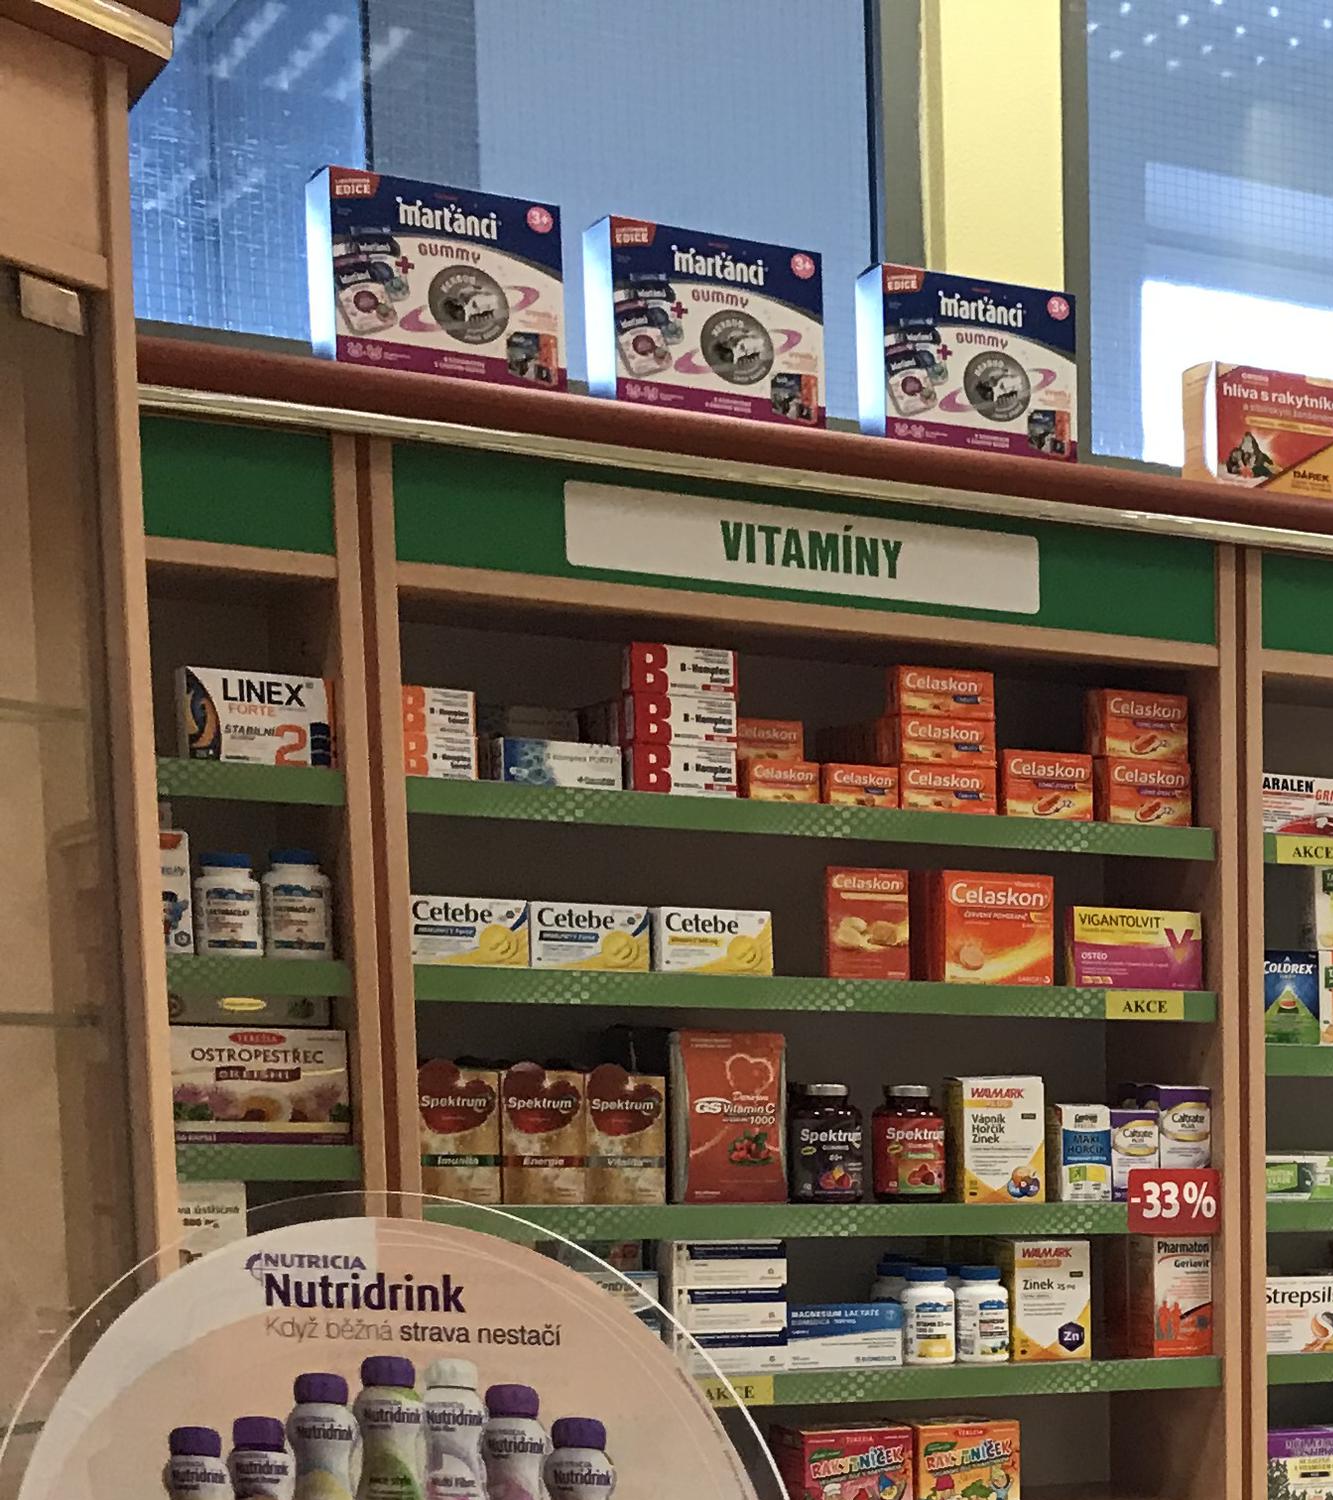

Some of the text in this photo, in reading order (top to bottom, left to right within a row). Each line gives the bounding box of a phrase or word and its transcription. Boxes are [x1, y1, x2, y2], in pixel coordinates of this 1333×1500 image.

[396, 196, 499, 241] marťánci
[418, 242, 481, 263] GUMMY
[671, 245, 767, 287] marťánci
[691, 288, 750, 309] GUMMY
[938, 290, 1025, 328] marťánci
[955, 331, 1010, 350] GUMMY
[1222, 381, 1257, 402] hlíva
[720, 520, 903, 580] VITAMÍNY
[221, 677, 306, 707] LINEX
[905, 672, 978, 695] Celaskon
[228, 704, 277, 718] FORTE
[1110, 697, 1182, 720] Celaskon
[907, 720, 980, 741] Celaskon
[274, 723, 308, 767] 2
[752, 766, 815, 782] Celaskon
[833, 770, 895, 788] Celaskon
[907, 769, 981, 790] Celaskon
[1009, 758, 1087, 781] Celaskon
[1113, 765, 1187, 787] Celaskon
[1292, 845, 1333, 860] AKCE
[832, 874, 904, 892] Celaskon
[950, 883, 1047, 908] Celaskon
[411, 900, 493, 924] Cetebe
[536, 906, 615, 930] Cetebe
[1078, 913, 1163, 931] VIGANTOLVIT
[665, 912, 739, 935] Cetebe
[1122, 1000, 1168, 1014] AKCE
[190, 1046, 324, 1066] OSTROPESTŘEC
[421, 1094, 488, 1111] Spektrum
[507, 1094, 573, 1111] Spektrum
[971, 1087, 1024, 1099] WALMARK
[591, 1097, 654, 1114] Spektrum
[723, 1102, 765, 1116] Vitamin
[750, 1115, 776, 1125] 1000
[972, 1112, 1006, 1127] Vápník
[972, 1122, 1005, 1134] Hořčík
[972, 1133, 1001, 1145] Zinek
[1157, 1240, 1210, 1257] Pharmaton
[264, 1253, 367, 1271] NUTRICIA
[264, 1273, 467, 1314] Nutridrink
[1023, 1278, 1054, 1291] Zinek
[266, 1314, 562, 1346] Když běžná strava nestačí
[811, 1440, 903, 1479] RAKYTNÍČEK
[925, 1438, 1014, 1472] RAKYTNÍČEK
